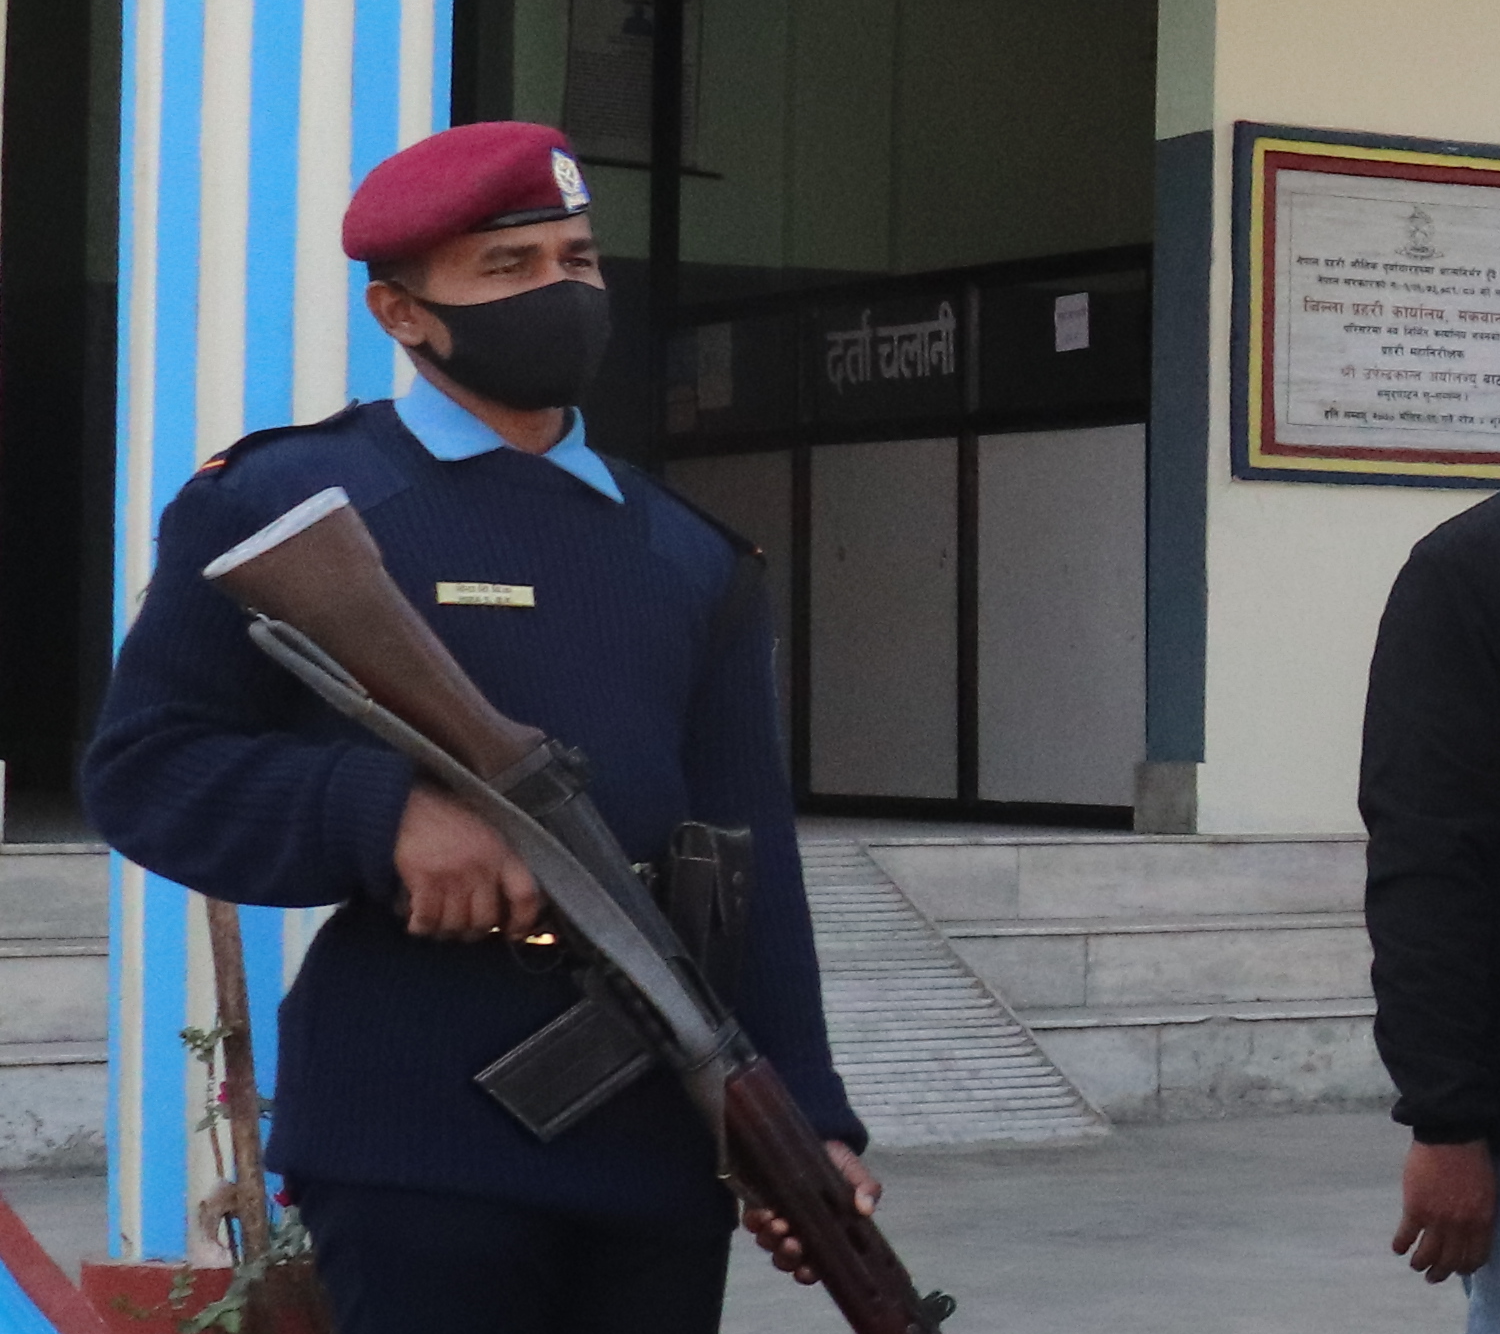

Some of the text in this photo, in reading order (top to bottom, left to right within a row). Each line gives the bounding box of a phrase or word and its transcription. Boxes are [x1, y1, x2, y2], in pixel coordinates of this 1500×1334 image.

[1303, 294, 1345, 315] जिल्ला
[1352, 299, 1384, 318] प्रहरी
[826, 300, 957, 394] दर्ता चलानी
[1381, 343, 1404, 357] प्रहरी
